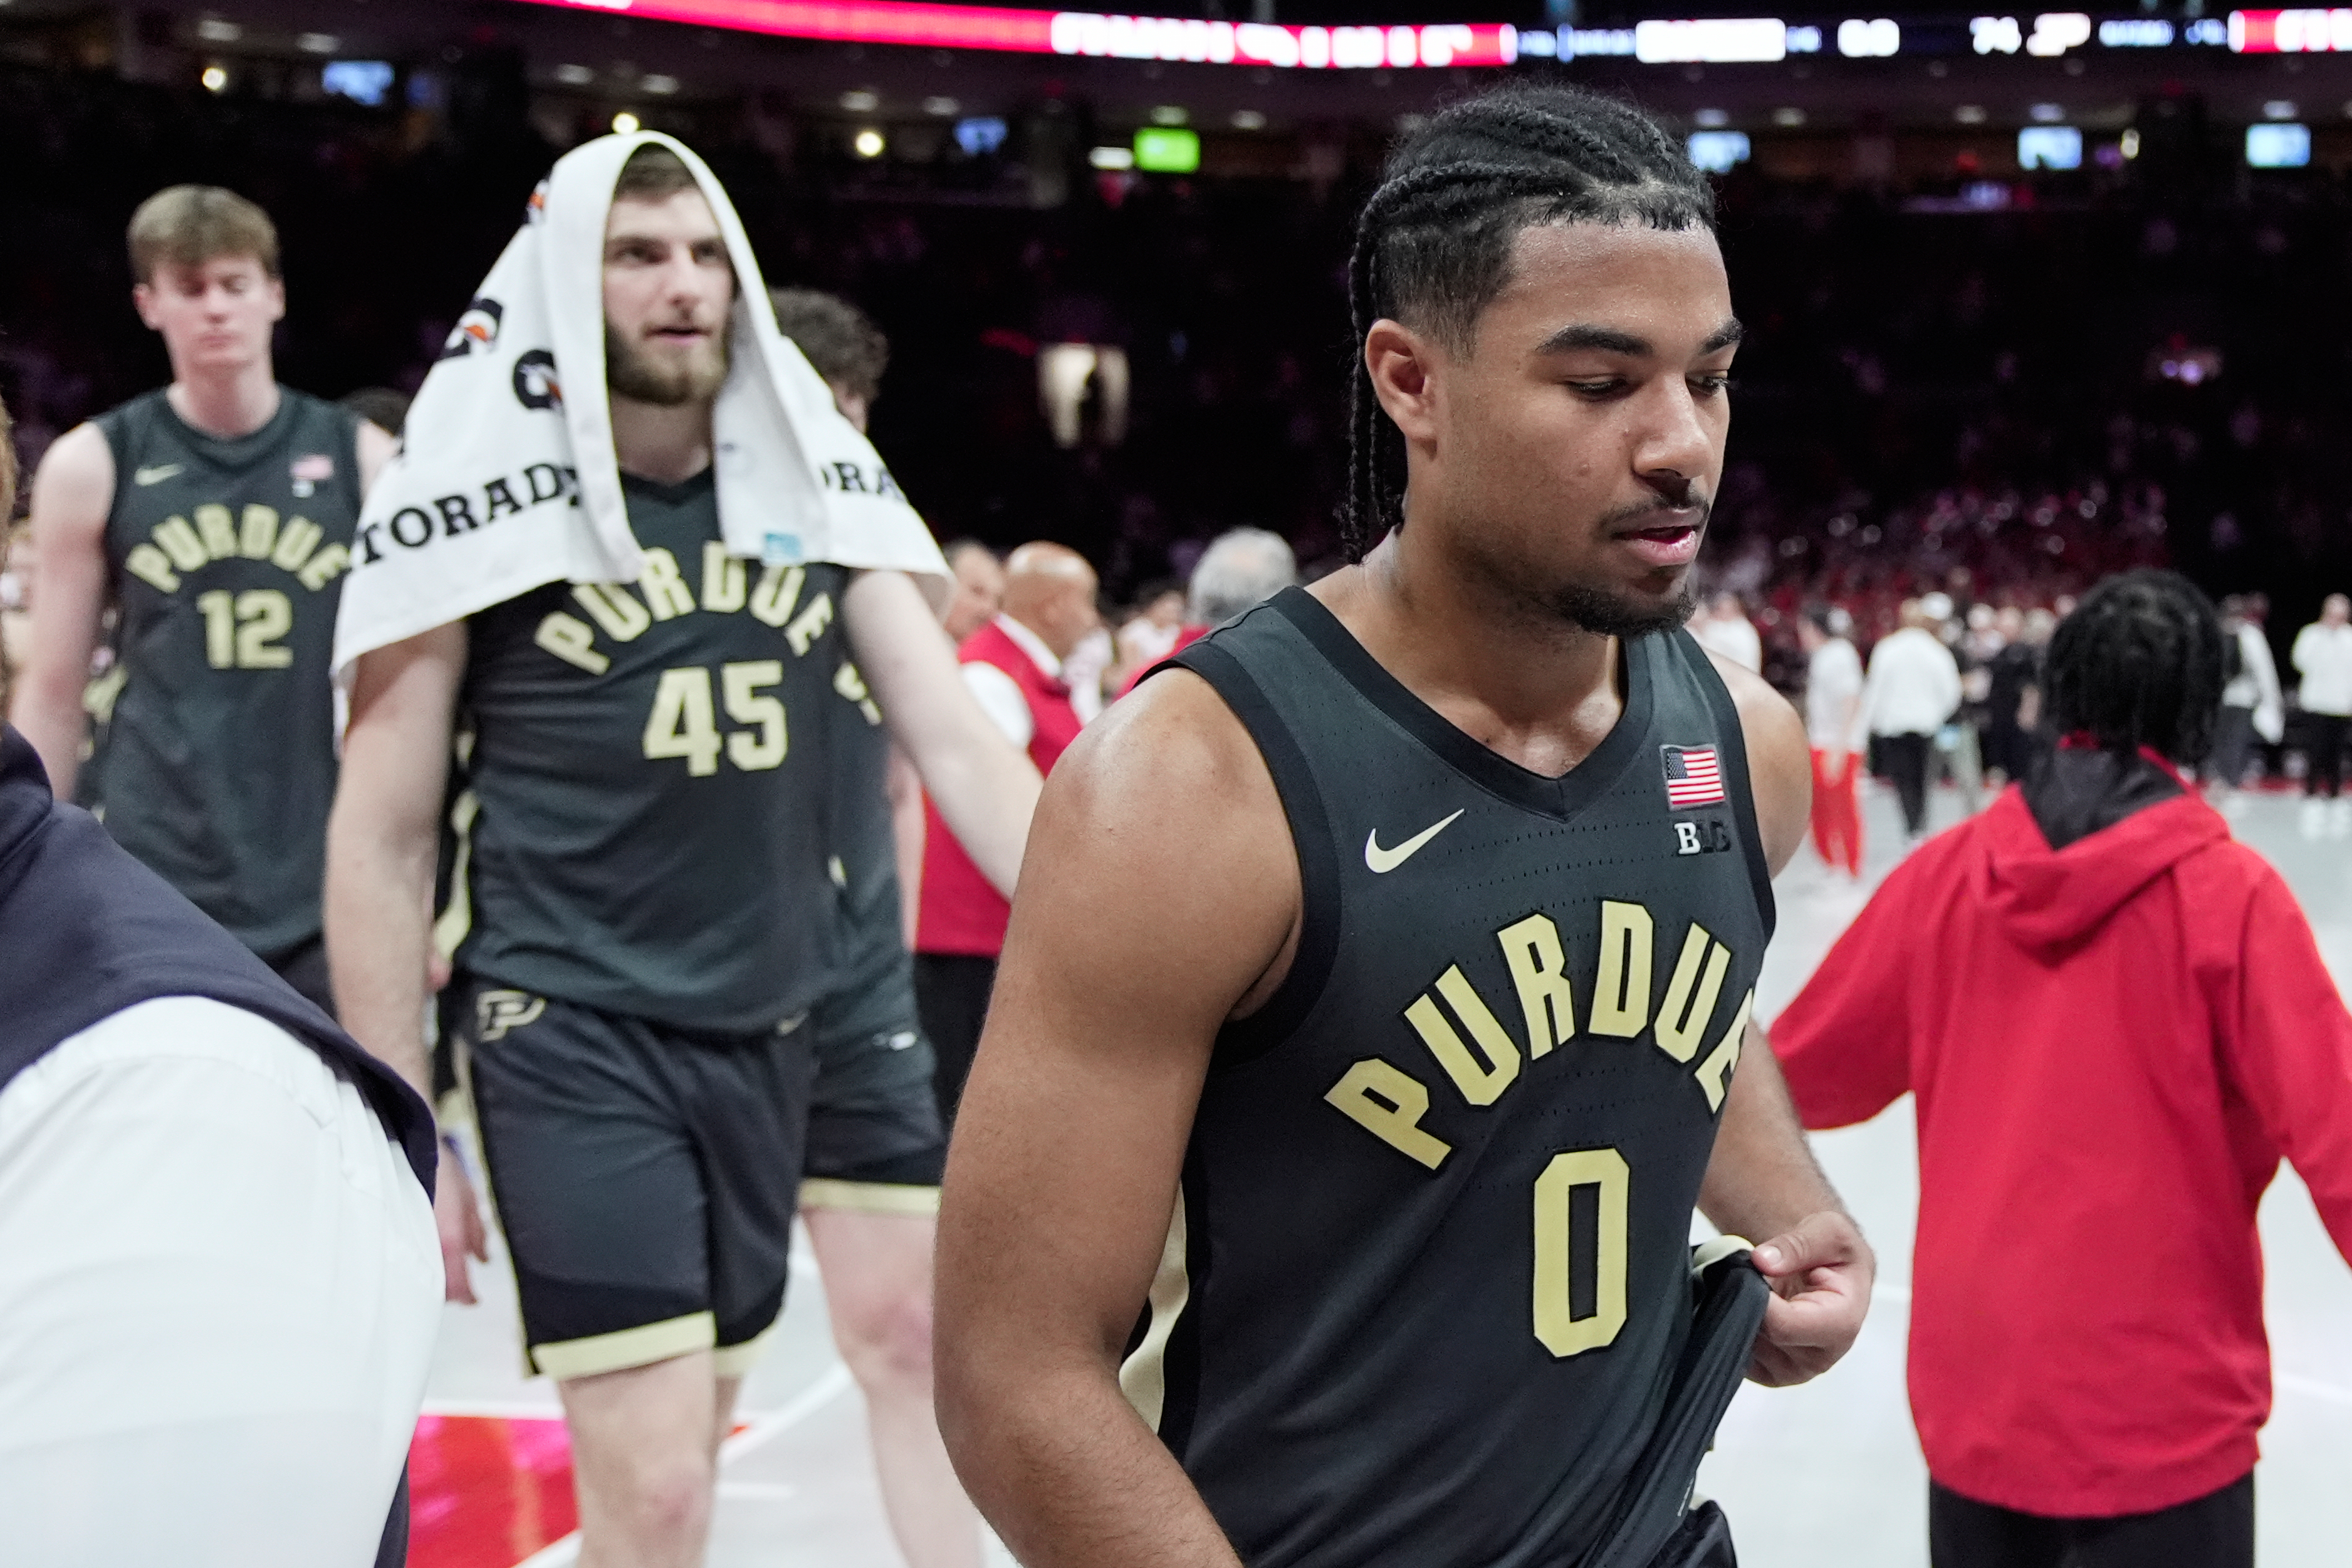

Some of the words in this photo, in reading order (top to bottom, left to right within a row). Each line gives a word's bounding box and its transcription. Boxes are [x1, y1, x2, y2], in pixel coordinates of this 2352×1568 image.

[125, 503, 352, 593] PURDUE
[361, 463, 578, 565] TORAD
[196, 588, 294, 670] 12
[534, 540, 835, 676] PURDUE
[642, 659, 788, 777] 45
[1533, 1147, 1630, 1358] 0
